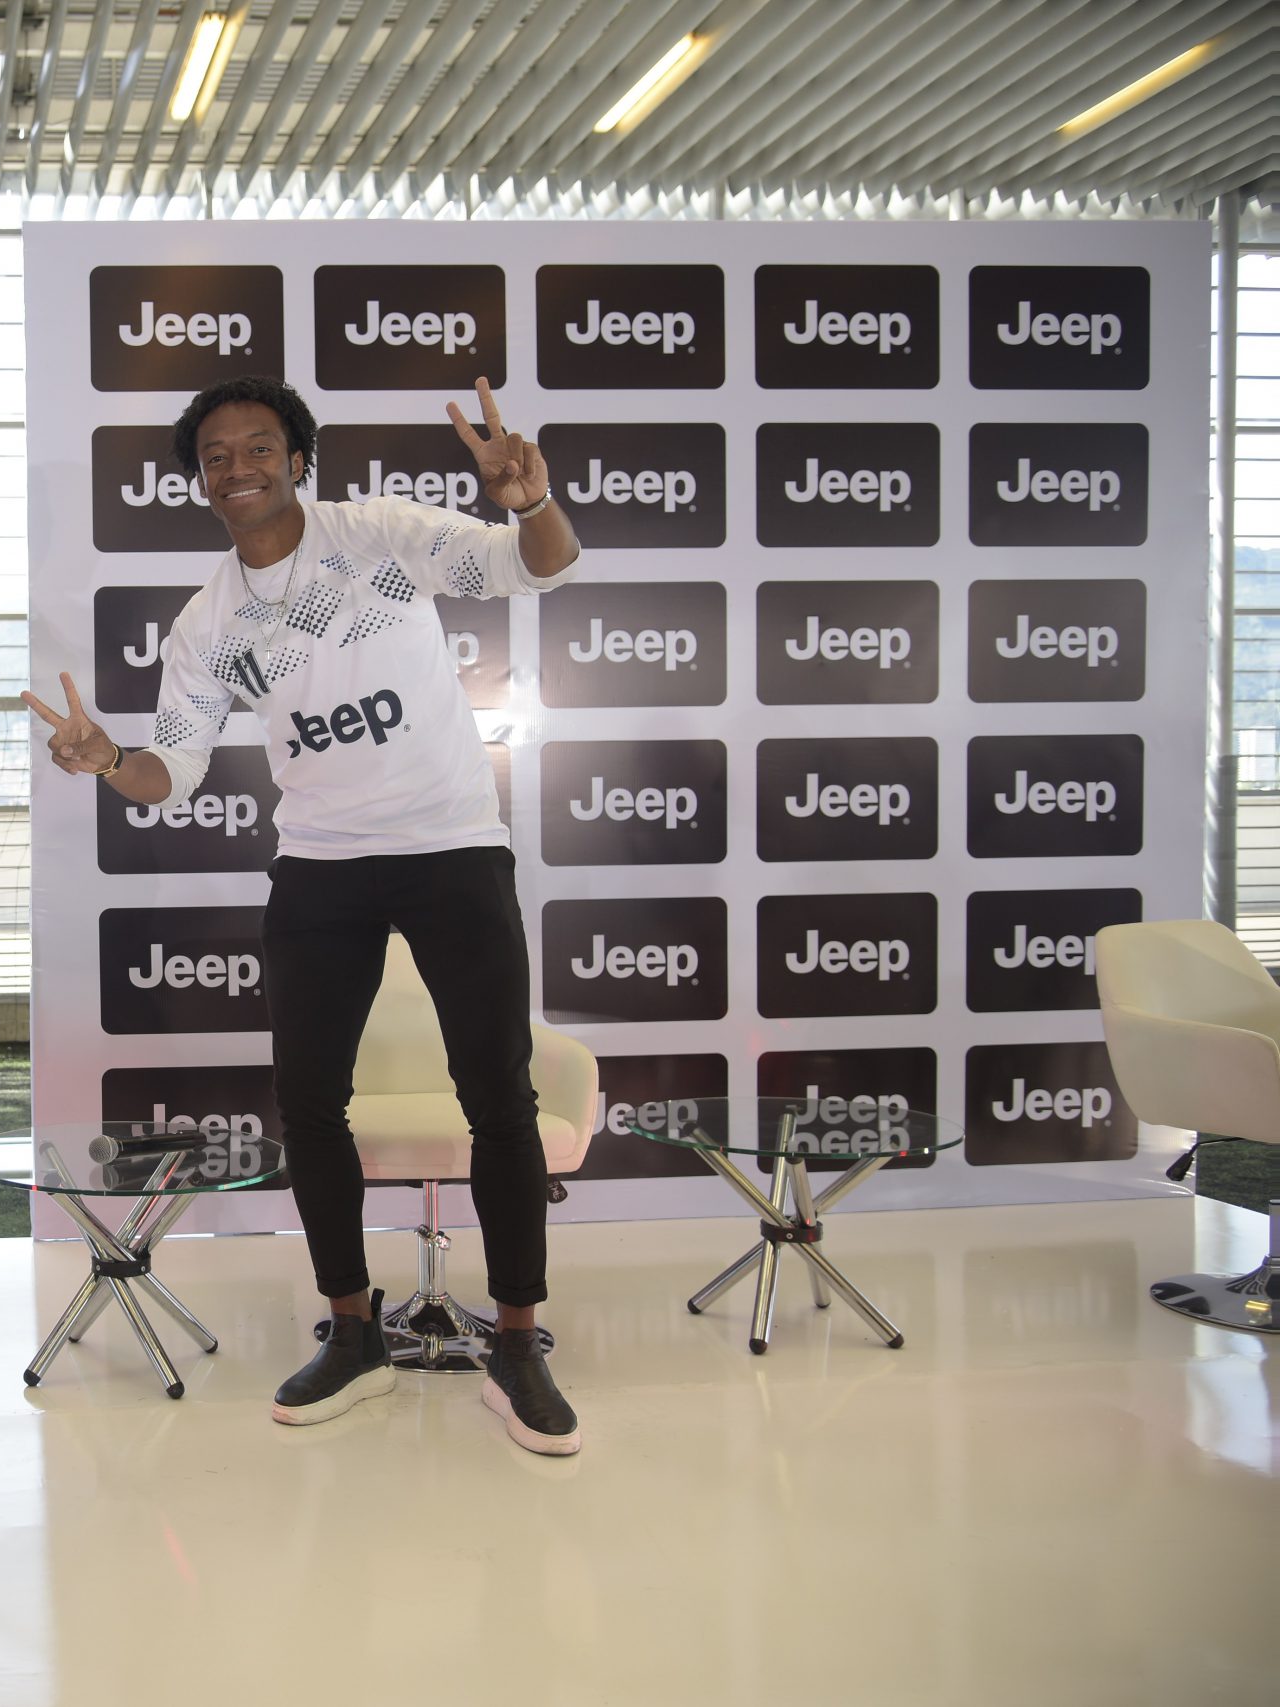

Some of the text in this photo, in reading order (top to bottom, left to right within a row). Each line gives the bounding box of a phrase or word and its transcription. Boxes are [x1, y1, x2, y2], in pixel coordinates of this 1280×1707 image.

[119, 302, 252, 355] Jeep
[345, 301, 477, 355] Jeep
[566, 300, 695, 354] Jeep
[784, 300, 911, 354] Jeep
[997, 301, 1122, 355] Jeep
[347, 460, 479, 512] Jeep
[567, 459, 697, 513] Jeep
[784, 459, 911, 512] Jeep
[997, 459, 1121, 512] Jeep
[569, 618, 697, 671] Jeep
[785, 617, 911, 669] Jeep
[995, 615, 1119, 668] Jeep
[570, 777, 698, 829] Jeep
[785, 774, 911, 826] Jeep
[994, 770, 1116, 822] Jeep
[128, 943, 261, 996] Jeep
[572, 935, 699, 986] Jeep
[785, 930, 910, 981] Jeep
[794, 1085, 909, 1131] Jeep
[992, 1078, 1112, 1128] Jeep
